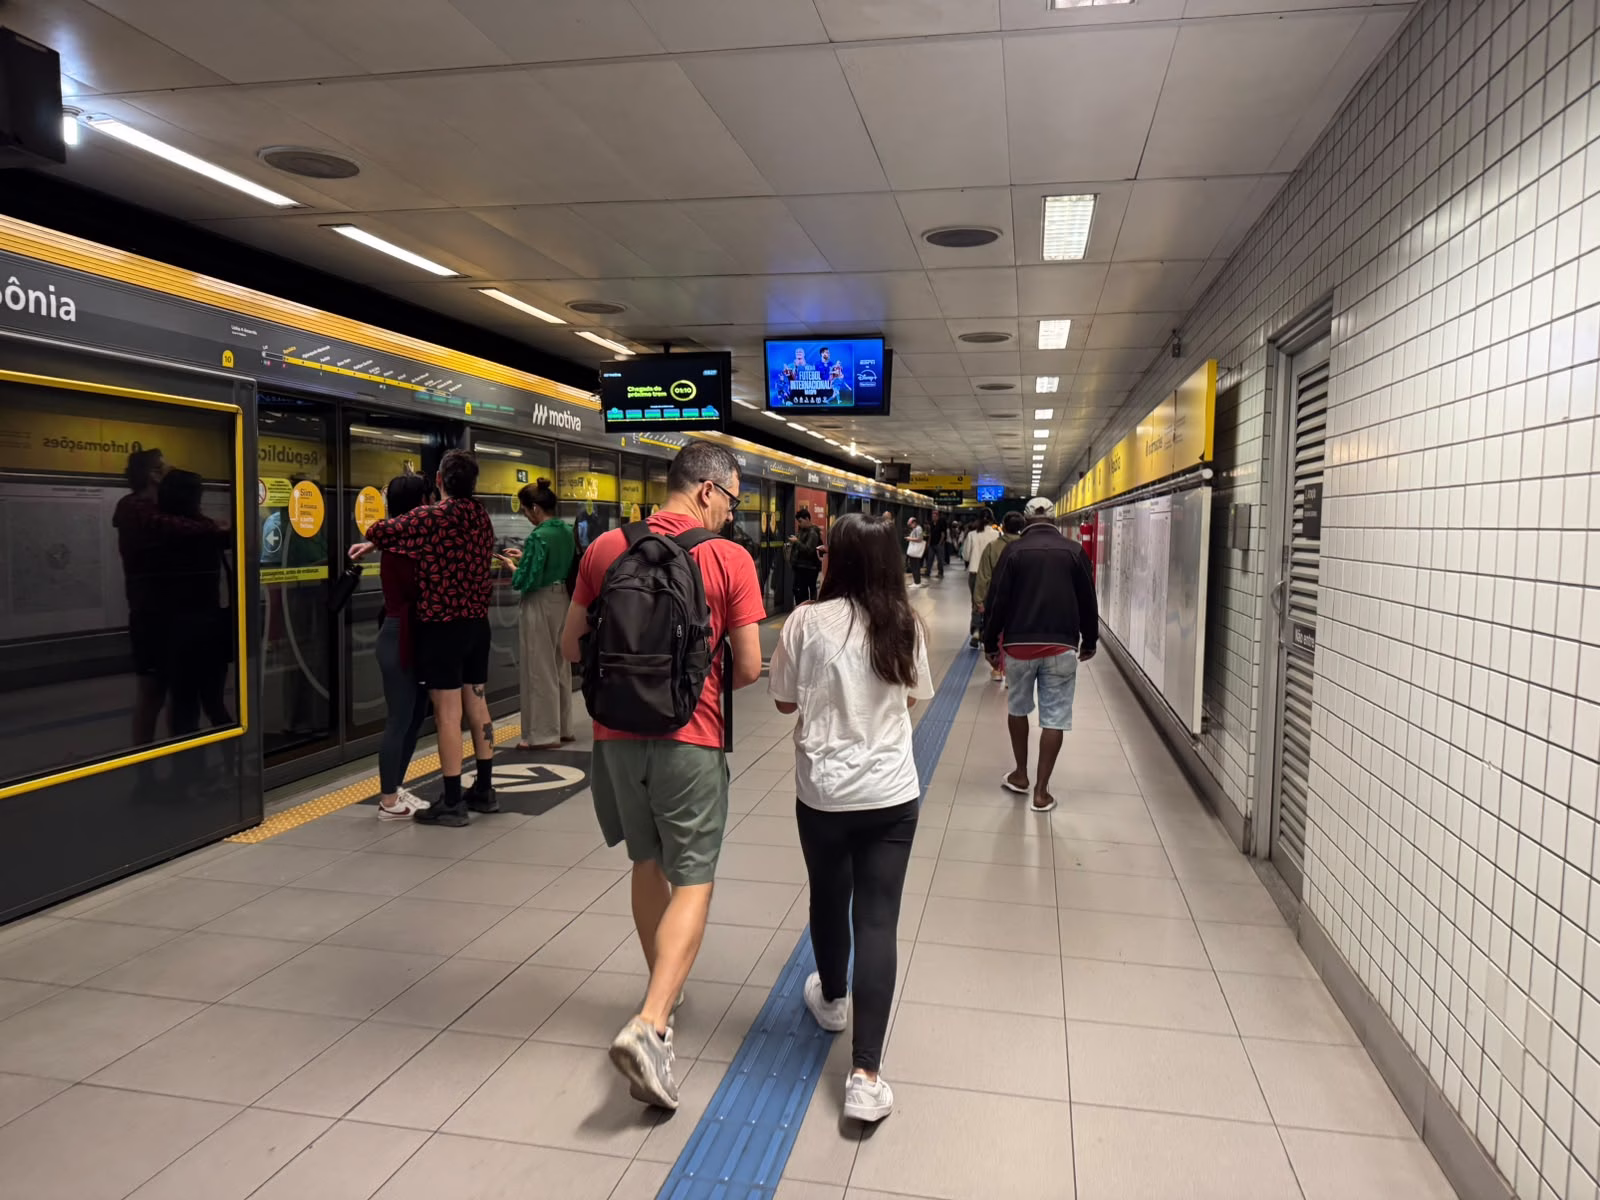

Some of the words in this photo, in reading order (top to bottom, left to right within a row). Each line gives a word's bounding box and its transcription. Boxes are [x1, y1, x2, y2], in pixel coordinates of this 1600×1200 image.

[0, 276, 76, 322] ônia
[799, 371, 821, 380] FUTEBOL
[857, 372, 877, 382] Disney+
[790, 380, 831, 390] INTERNACIONAL
[549, 409, 581, 432] motiva
[300, 488, 313, 496] Sim
[1294, 628, 1303, 643] Não
[1303, 632, 1315, 648] entre
